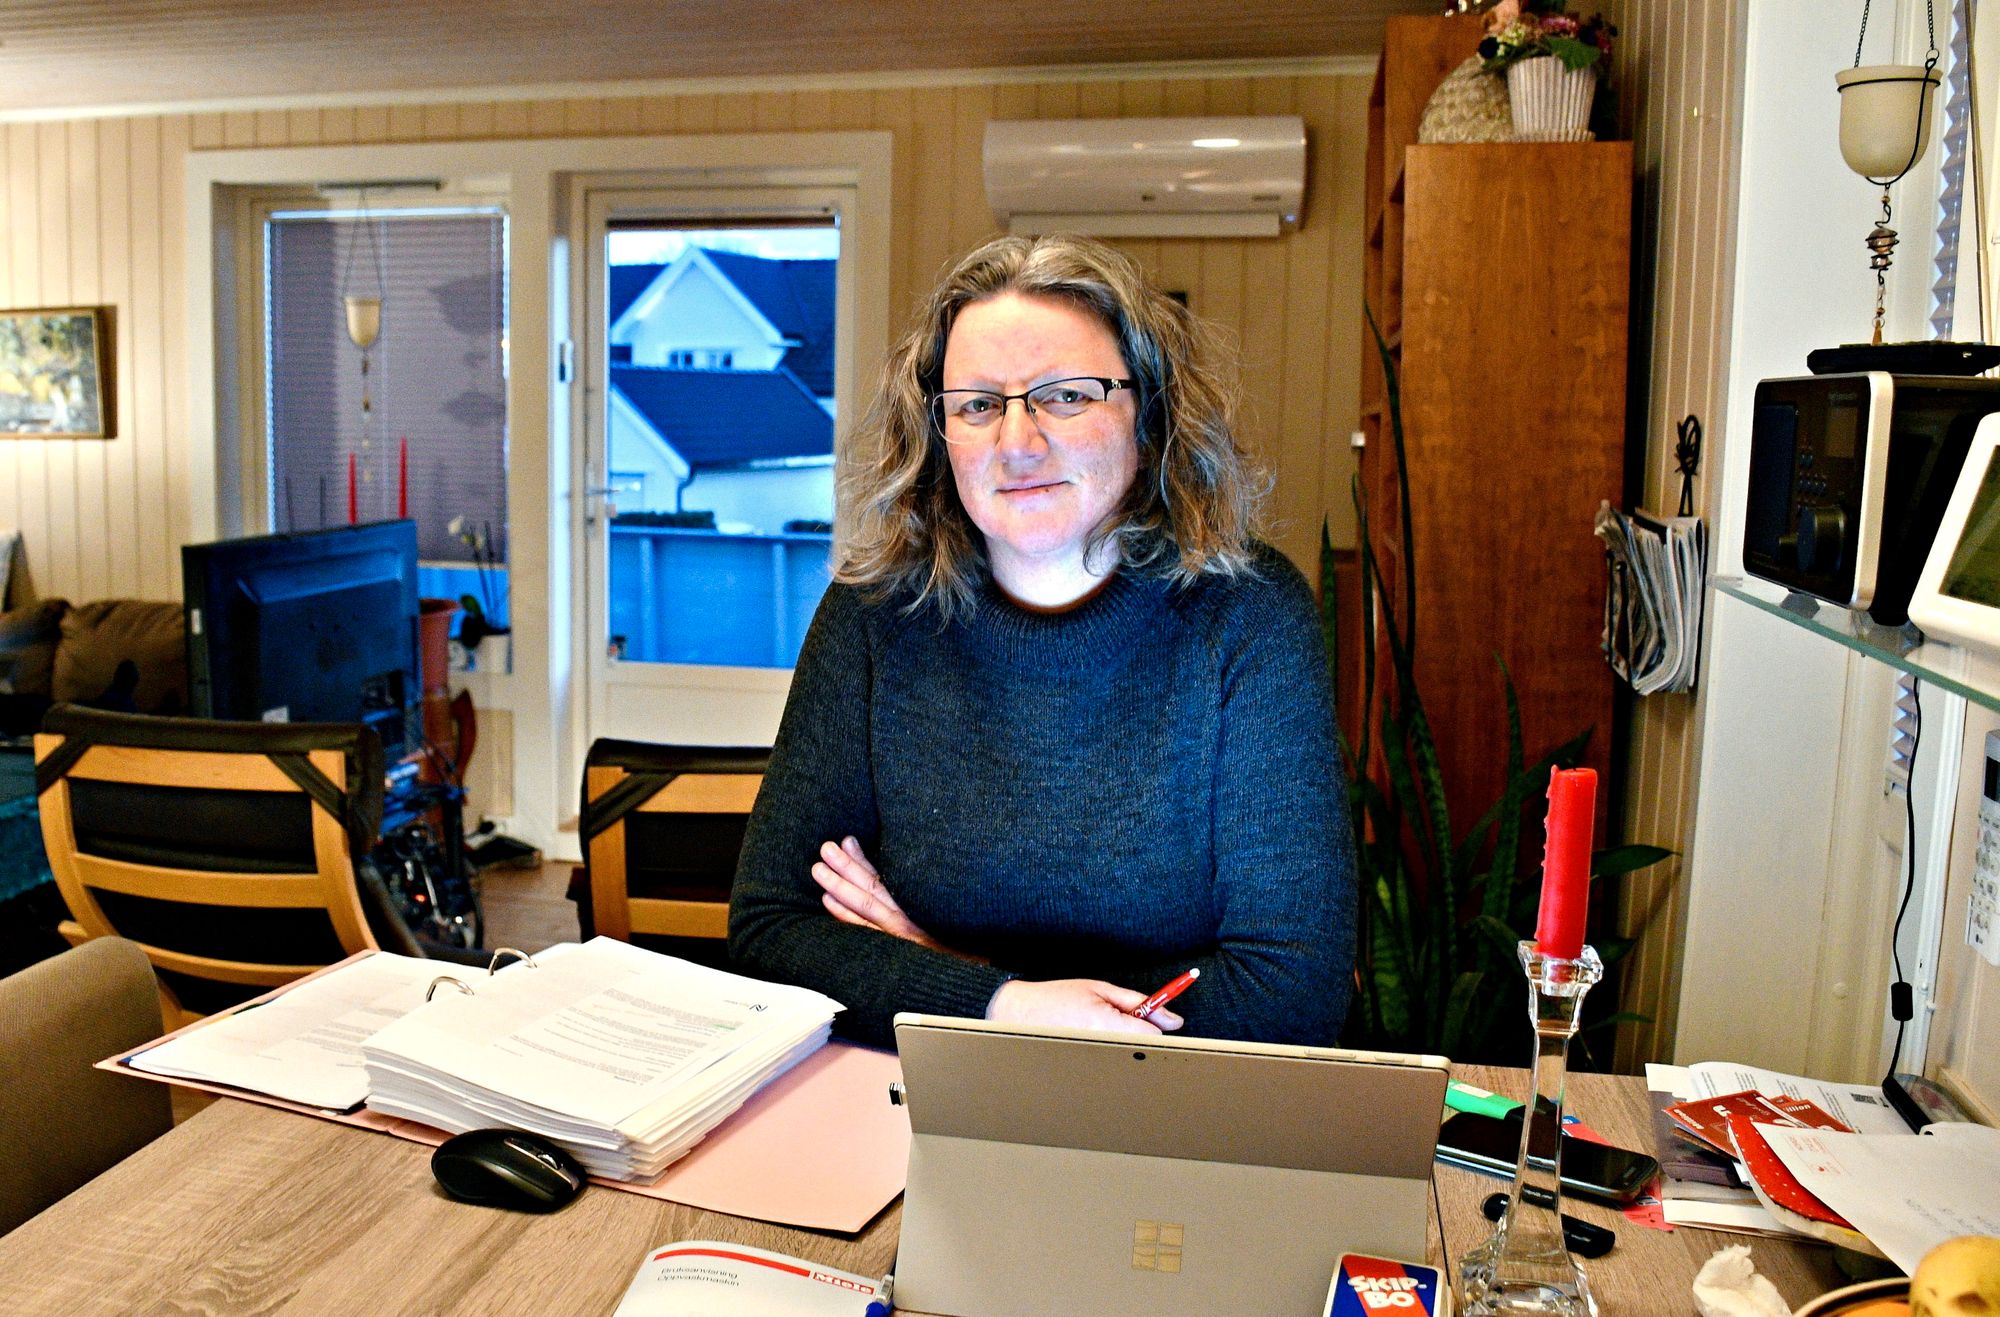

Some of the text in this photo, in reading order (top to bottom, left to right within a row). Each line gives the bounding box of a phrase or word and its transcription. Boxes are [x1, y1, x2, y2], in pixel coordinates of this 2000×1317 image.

[1783, 1103, 1811, 1113] illion
[814, 1272, 873, 1294] Miele
[1362, 1291, 1416, 1309] BO
